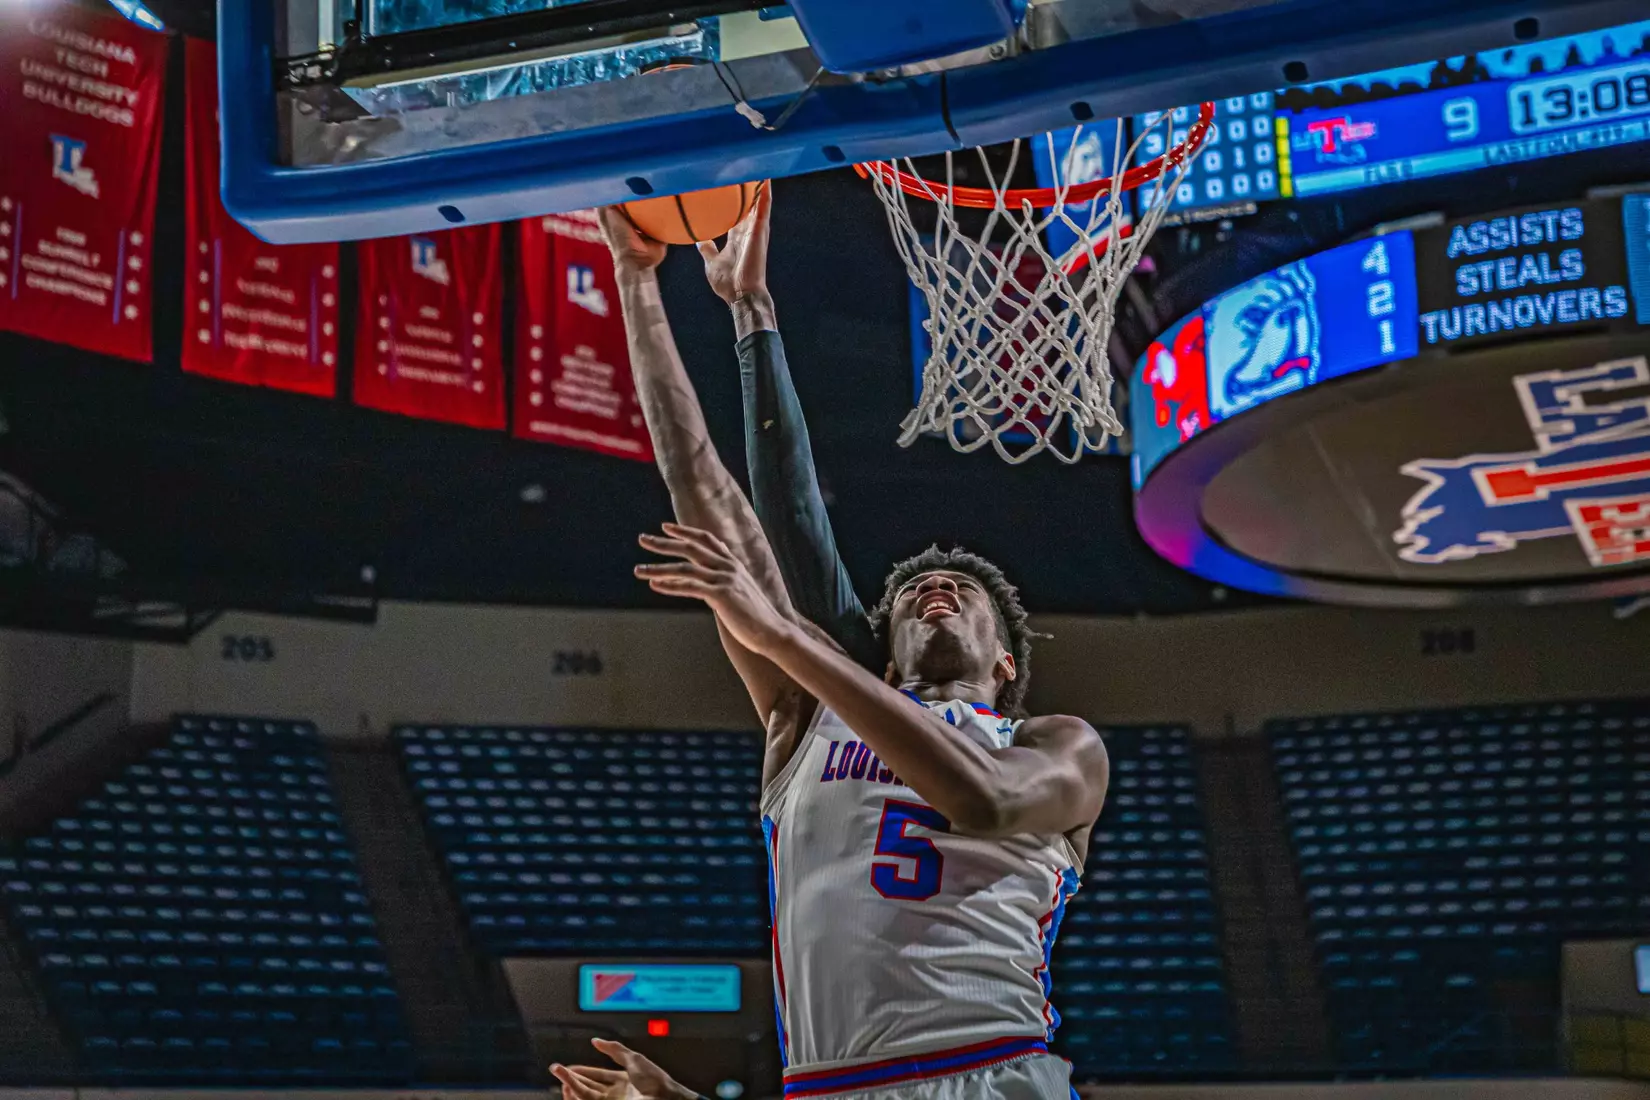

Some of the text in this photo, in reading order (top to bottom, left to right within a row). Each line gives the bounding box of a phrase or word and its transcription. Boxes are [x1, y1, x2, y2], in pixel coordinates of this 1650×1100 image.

[29, 20, 135, 64] LOUISIANA
[55, 45, 108, 78] TECH
[20, 57, 138, 106] UNIVERSITY
[1518, 73, 1650, 126] 13:08
[22, 81, 134, 127] BULLDOGS
[1444, 97, 1476, 140] 9
[1228, 120, 1246, 142] 0
[1252, 114, 1271, 137] 0
[1204, 150, 1223, 172] 0
[1254, 141, 1273, 164] 0
[1176, 182, 1194, 205] 0
[1206, 177, 1224, 199] 0
[1232, 173, 1250, 196] 0
[1256, 169, 1275, 191] 0
[1447, 207, 1584, 258] ASSISTS
[1362, 241, 1389, 275] 4
[1456, 248, 1585, 296] STEALS
[1367, 279, 1395, 317] 2
[1419, 285, 1628, 344] TURNOVERS
[1378, 319, 1396, 356] 1
[870, 798, 951, 901] 5
